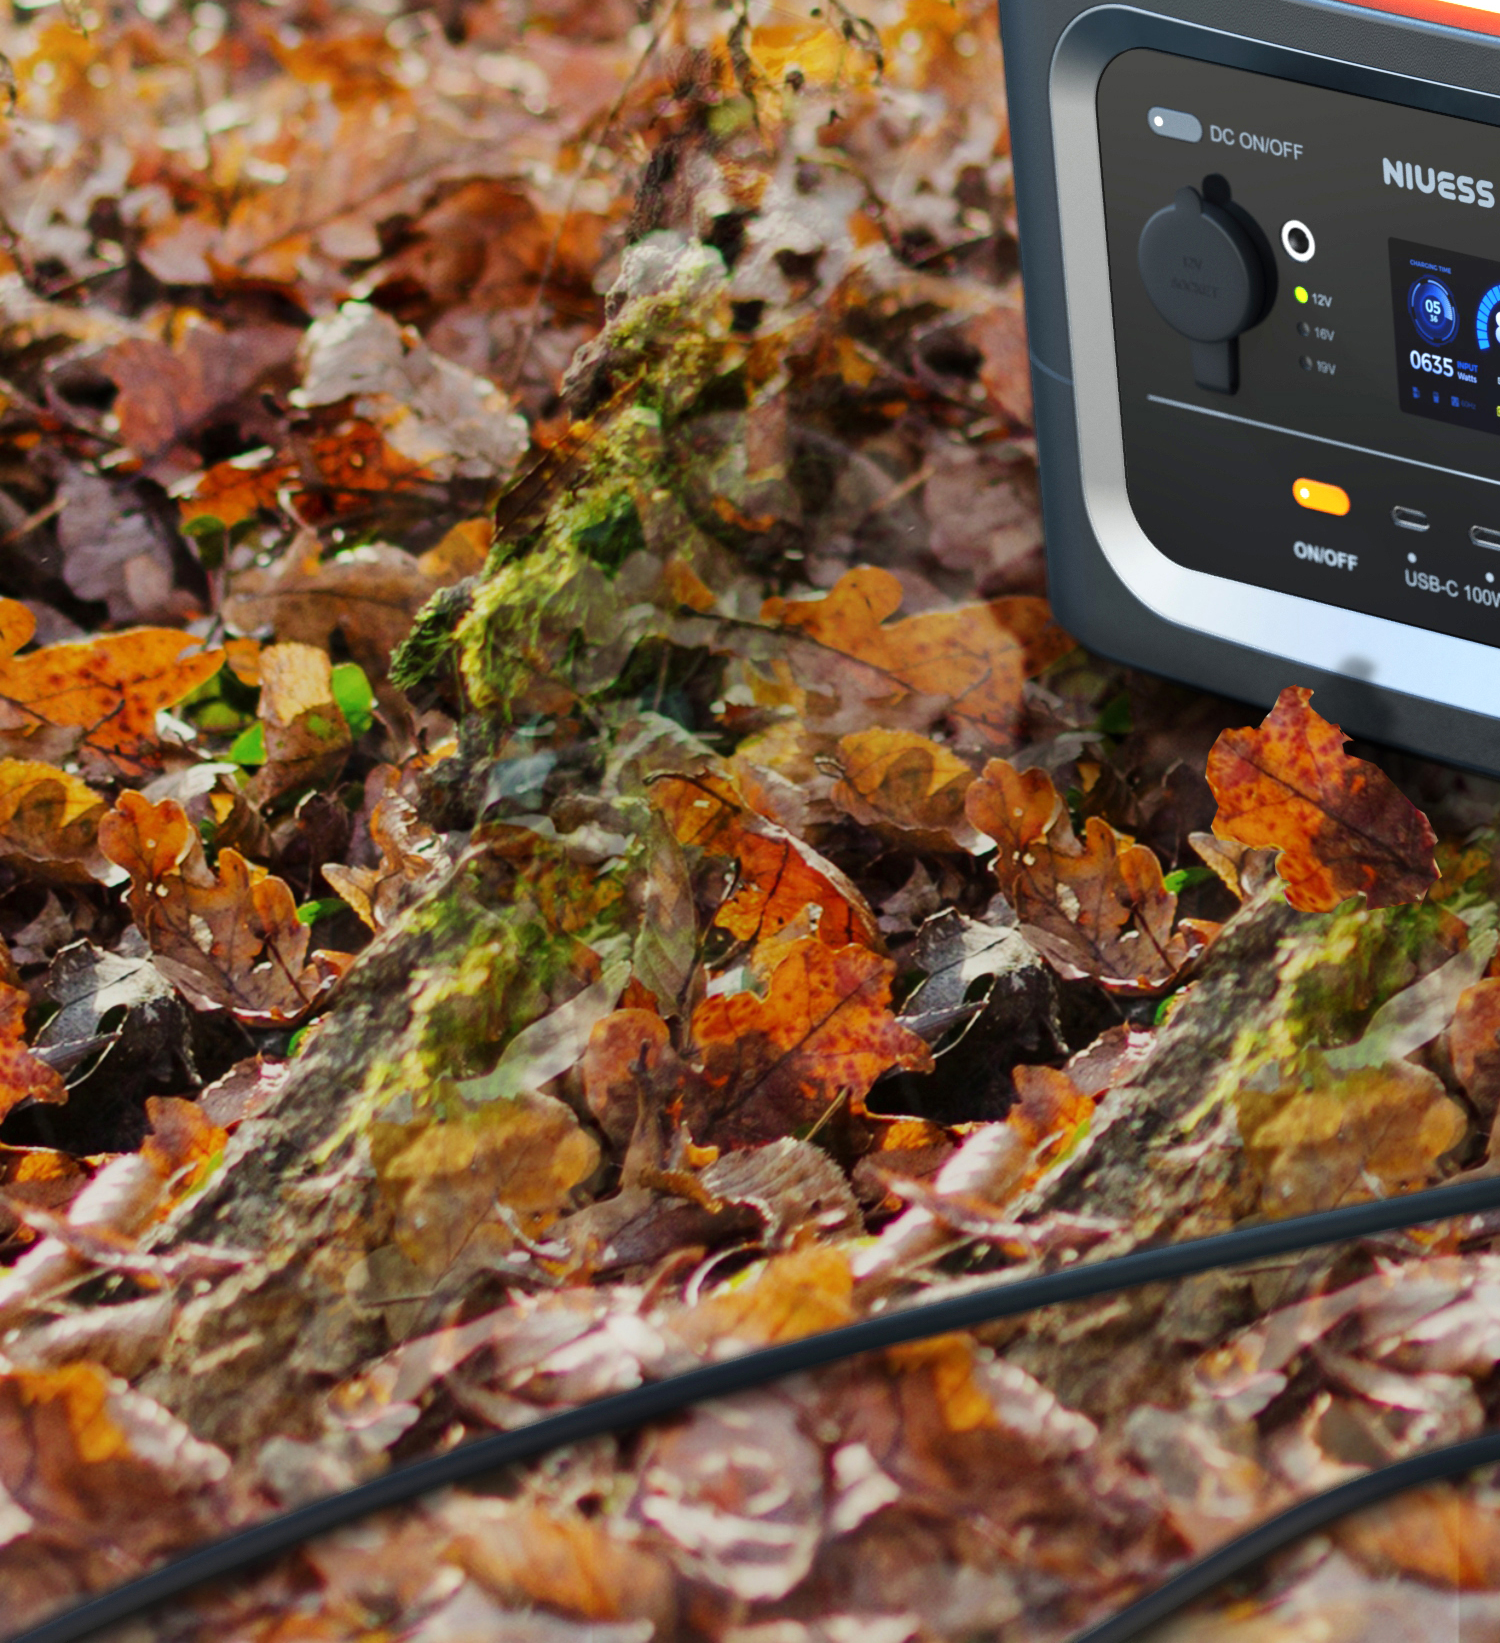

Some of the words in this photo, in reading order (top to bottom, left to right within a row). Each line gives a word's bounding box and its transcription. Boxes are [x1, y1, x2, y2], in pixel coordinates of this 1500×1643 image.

[1210, 124, 1235, 146] DC
[1239, 132, 1304, 160] ON/OFF
[1382, 157, 1496, 209] NIUESS
[1409, 259, 1438, 272] CHARGING
[1439, 266, 1452, 275] TIME
[1312, 293, 1333, 308] 12V
[1425, 299, 1442, 315] 05
[1430, 314, 1439, 323] 36
[1314, 326, 1336, 342] 16V
[1316, 360, 1337, 376] 19V
[1409, 349, 1455, 378] 0635
[1457, 361, 1479, 373] INPUT
[1457, 371, 1478, 384] Watts
[1293, 540, 1359, 572] ON/OFF
[1404, 568, 1459, 598] USB-C
